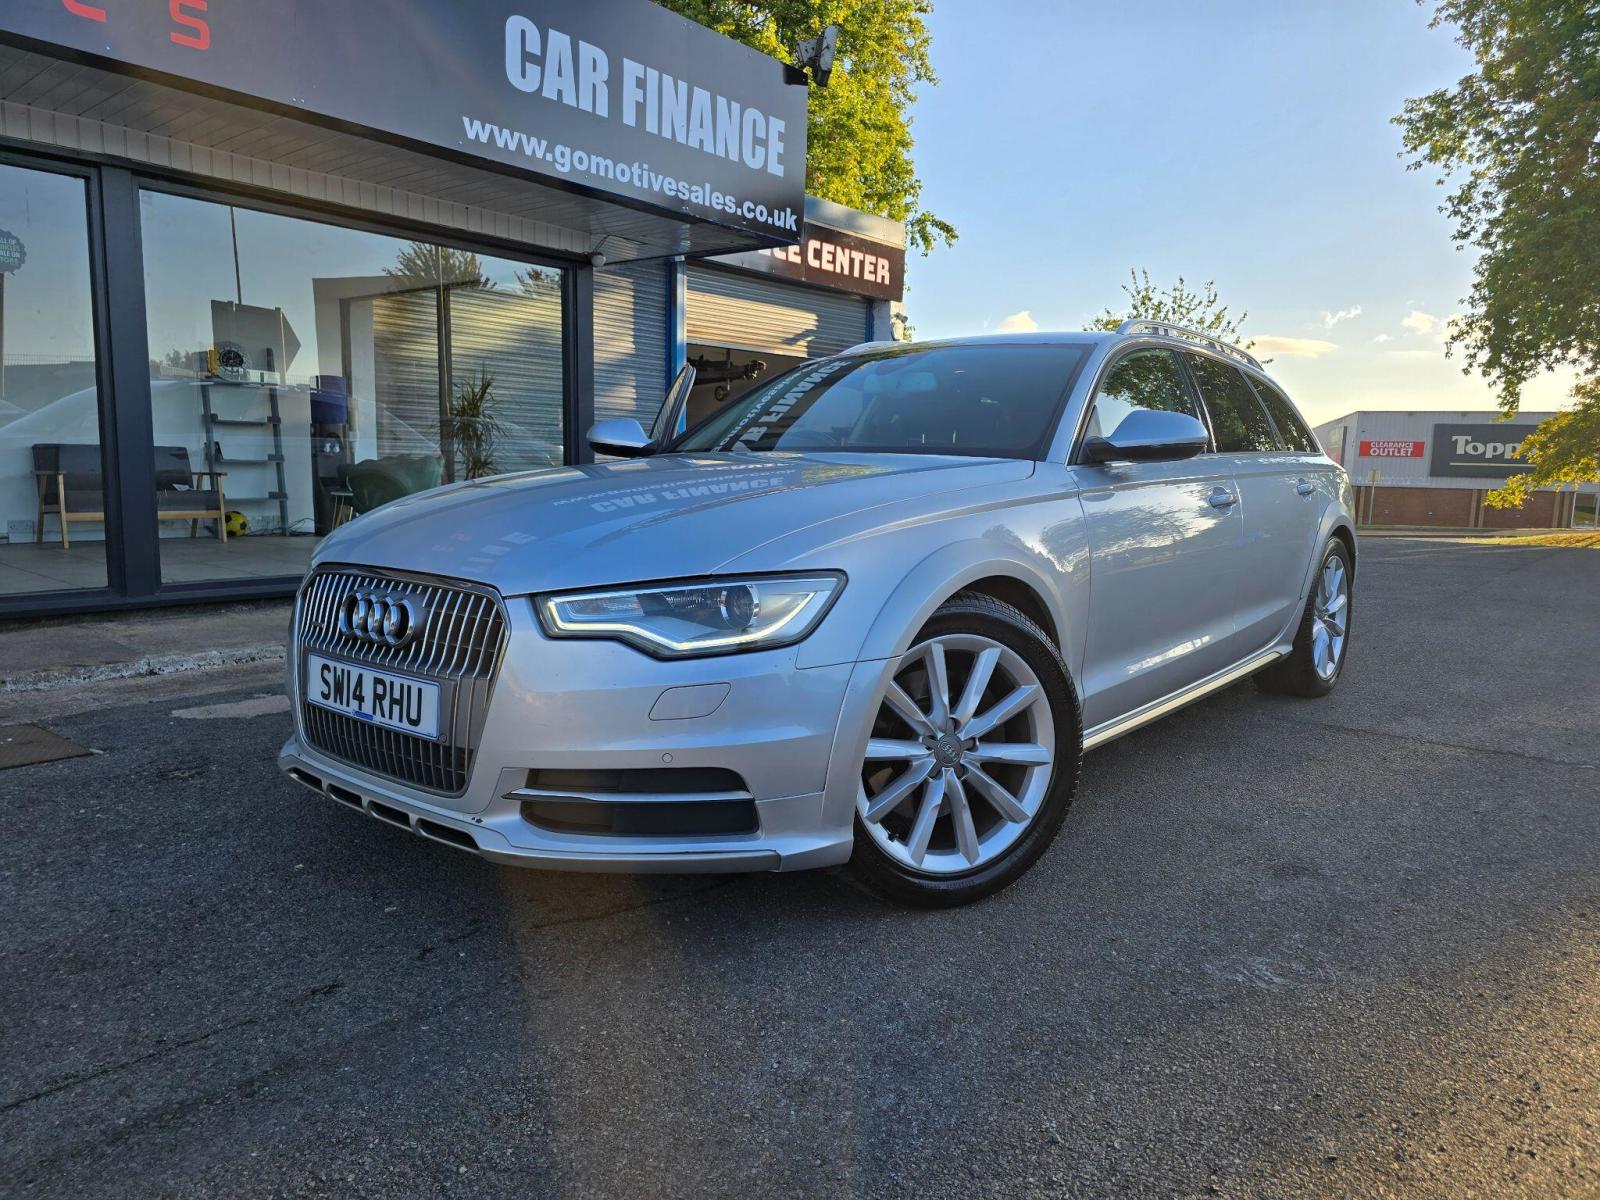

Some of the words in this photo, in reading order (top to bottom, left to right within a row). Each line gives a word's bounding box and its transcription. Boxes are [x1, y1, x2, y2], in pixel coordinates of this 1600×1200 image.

[505, 14, 609, 119] CAR
[622, 57, 786, 178] FINANCE
[462, 115, 798, 232] www.gomotivesales.co.uk
[807, 239, 890, 286] CENTER
[1369, 448, 1414, 457] OUTLET
[1370, 441, 1414, 449] CLEARANCE
[1451, 435, 1522, 459] Topp
[319, 662, 365, 712] SW14
[371, 676, 423, 727] RHU
